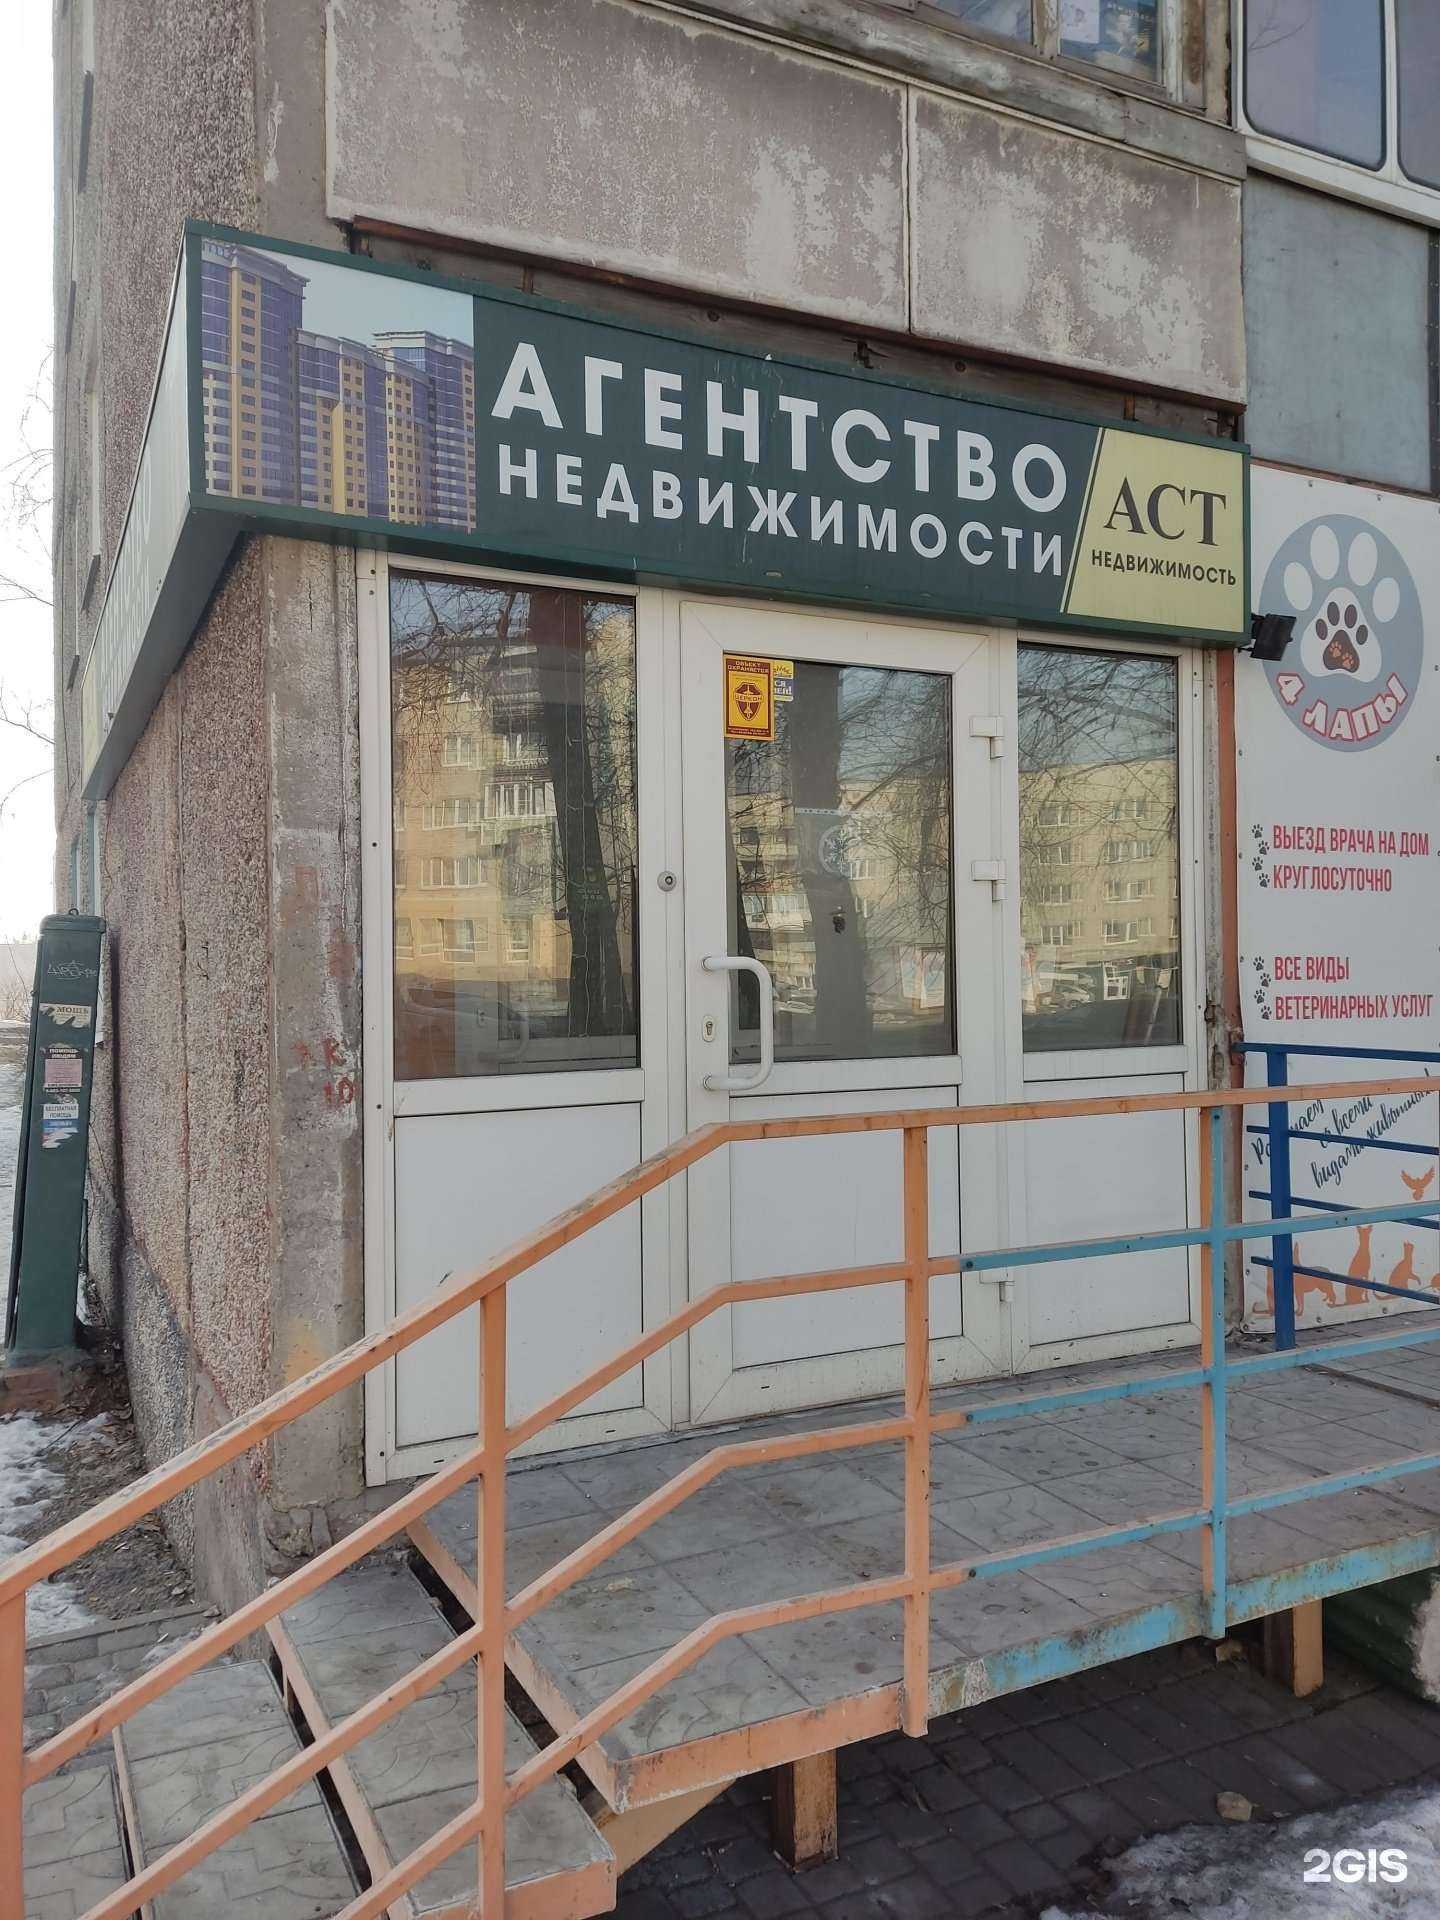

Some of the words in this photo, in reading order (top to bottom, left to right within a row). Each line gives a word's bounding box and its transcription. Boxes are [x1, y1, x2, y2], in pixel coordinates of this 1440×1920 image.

[491, 343, 1067, 513] АГЕНТСТВО
[498, 444, 1062, 577] НЕДВИЖИМОСТИ
[1103, 477, 1227, 546] АСТ
[1091, 549, 1236, 587] НЕДВИЖИМОСТЬ
[1277, 673, 1305, 705] 4
[1303, 673, 1408, 741] ЛАПЫ
[1273, 825, 1325, 853] ВЫЕЗД
[1330, 828, 1375, 854] ВРАЧА
[1378, 831, 1396, 855] НА
[1400, 832, 1430, 857] ДОМ
[1273, 865, 1392, 892] КРУГЛОСУТОЧНО
[1274, 956, 1302, 981] ВСЕ
[1306, 956, 1350, 983] ВИДЫ
[1275, 994, 1388, 1021] ВЕТЕРИНАРНЫХ
[1392, 994, 1434, 1019] УСЛУГ
